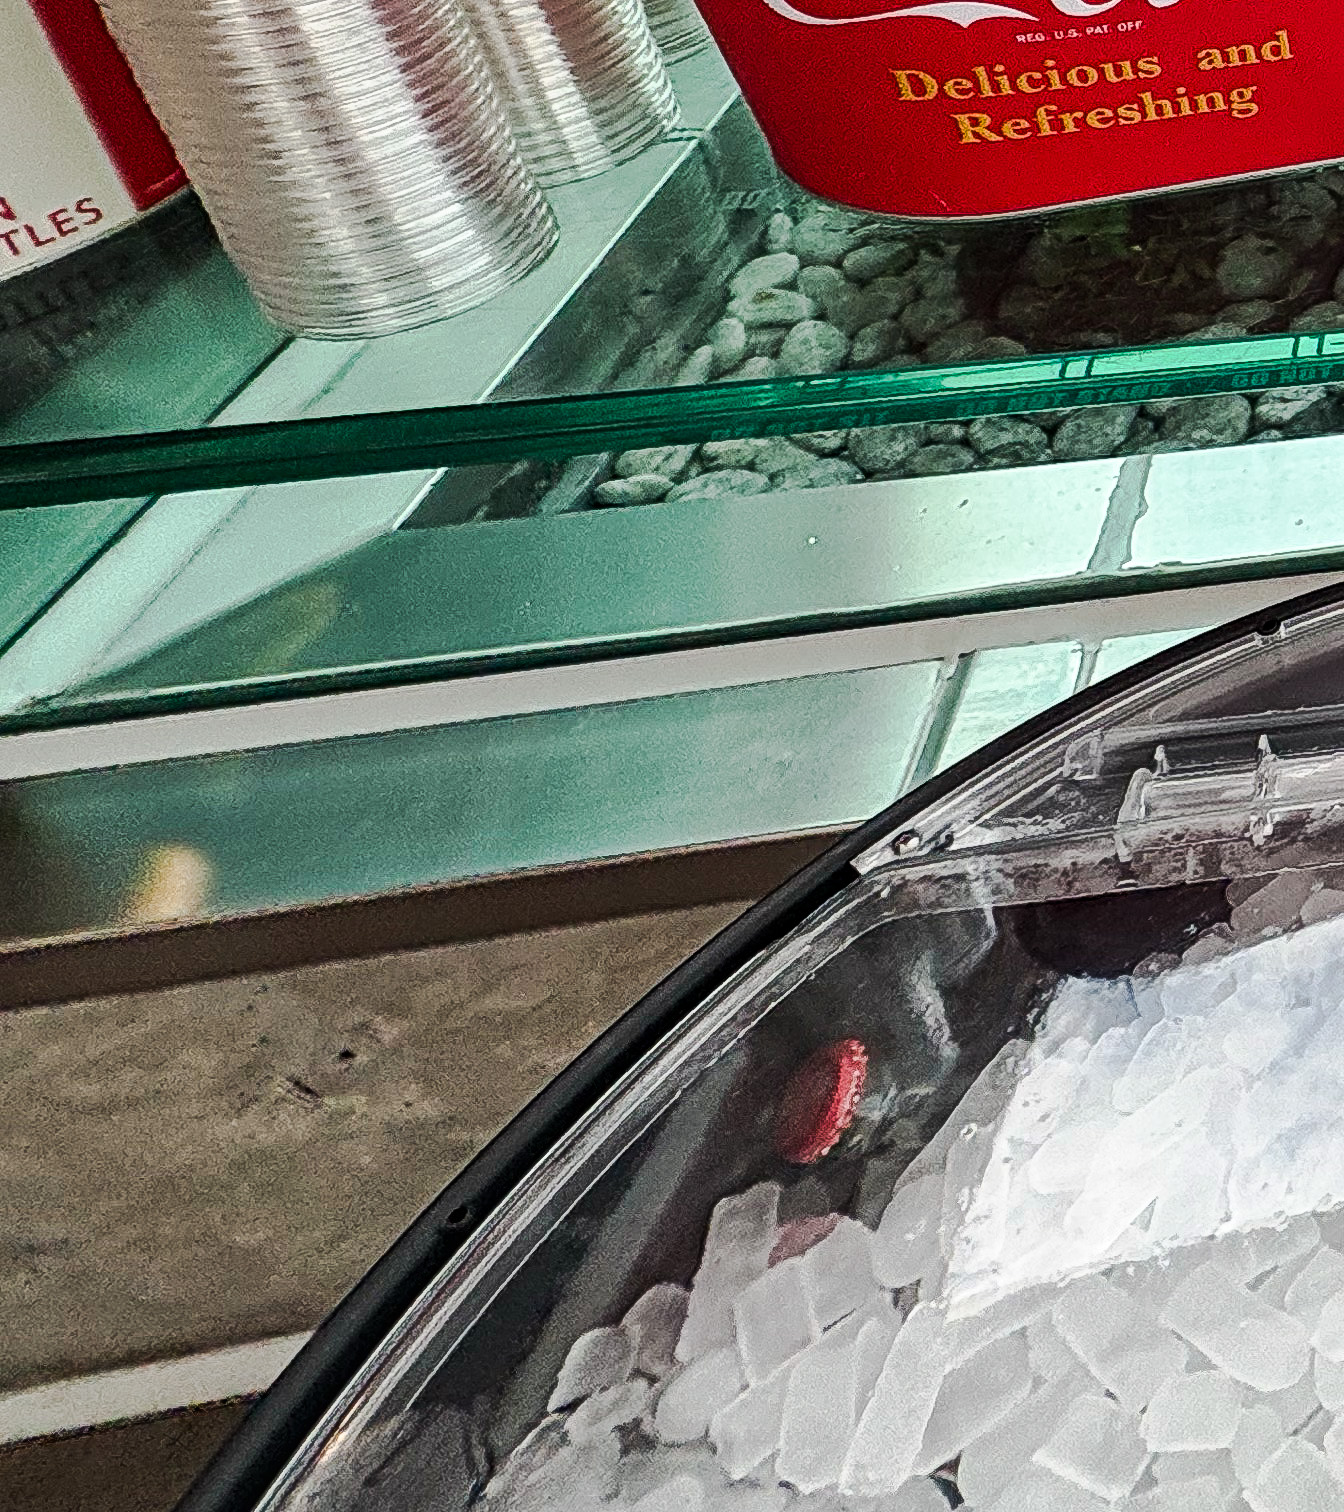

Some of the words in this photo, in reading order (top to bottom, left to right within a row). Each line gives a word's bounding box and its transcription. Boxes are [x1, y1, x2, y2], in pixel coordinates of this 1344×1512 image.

[888, 48, 1161, 102] Delicious
[1197, 28, 1295, 70] and
[950, 83, 1260, 146] Refreshing
[0, 197, 103, 257] TLES
